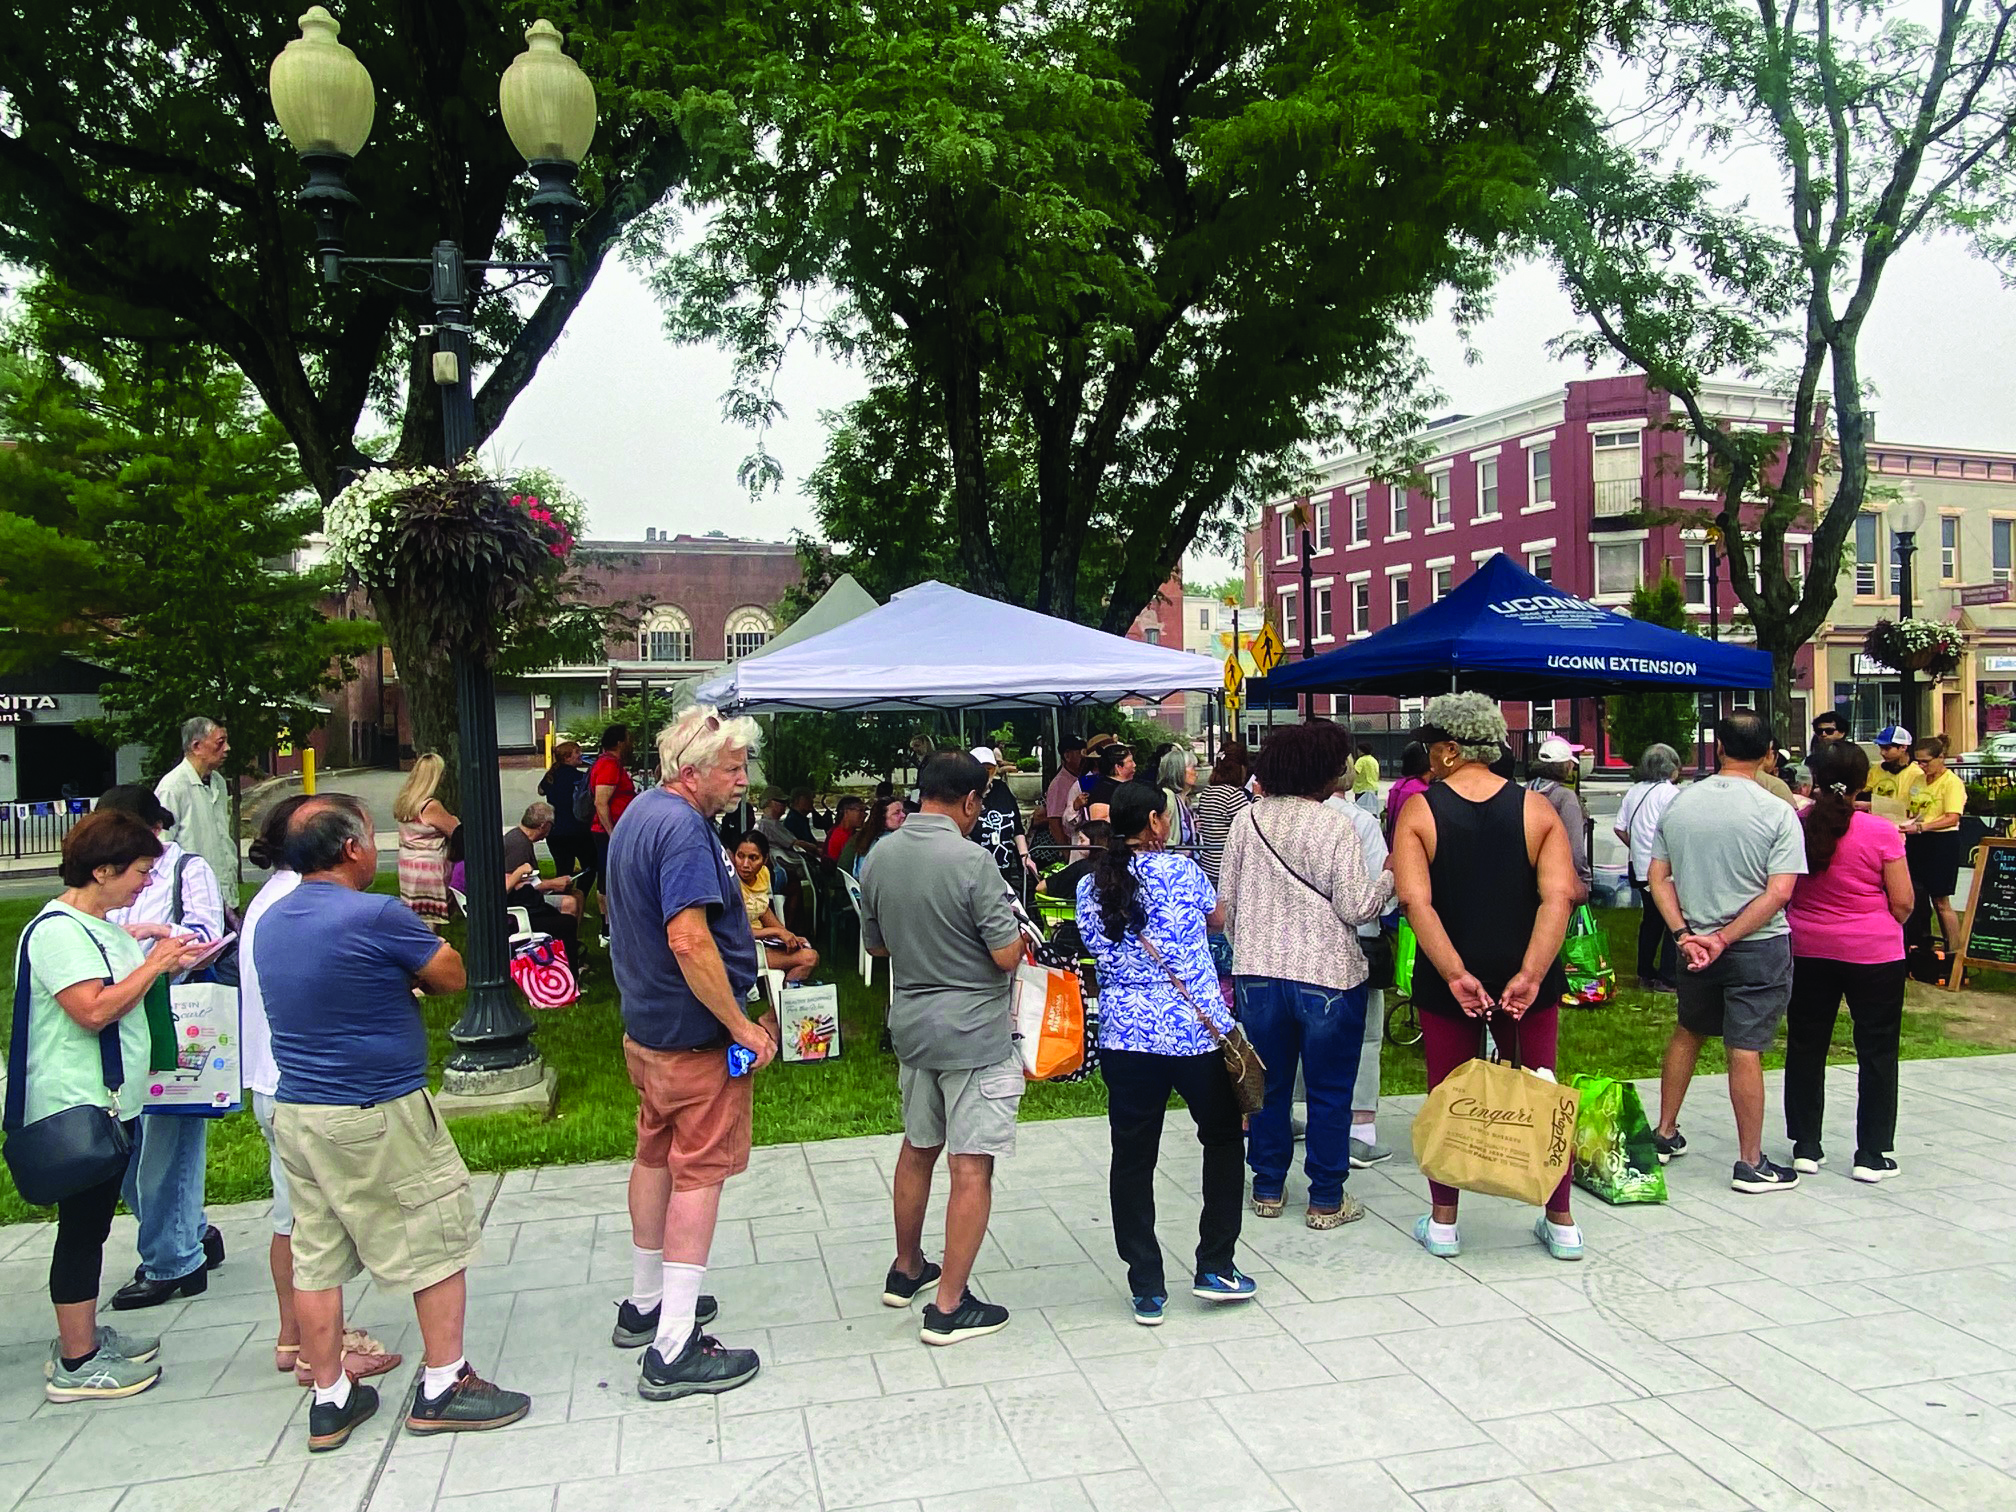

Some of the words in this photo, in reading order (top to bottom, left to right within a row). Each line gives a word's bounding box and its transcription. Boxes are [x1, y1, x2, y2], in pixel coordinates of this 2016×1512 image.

[1488, 596, 1601, 614] UCONN
[1547, 655, 1606, 671] UCONN
[1609, 656, 1698, 676] EXTENSION
[1449, 1097, 1534, 1129] Cingari
[1547, 1096, 1575, 1168] ShopRite
